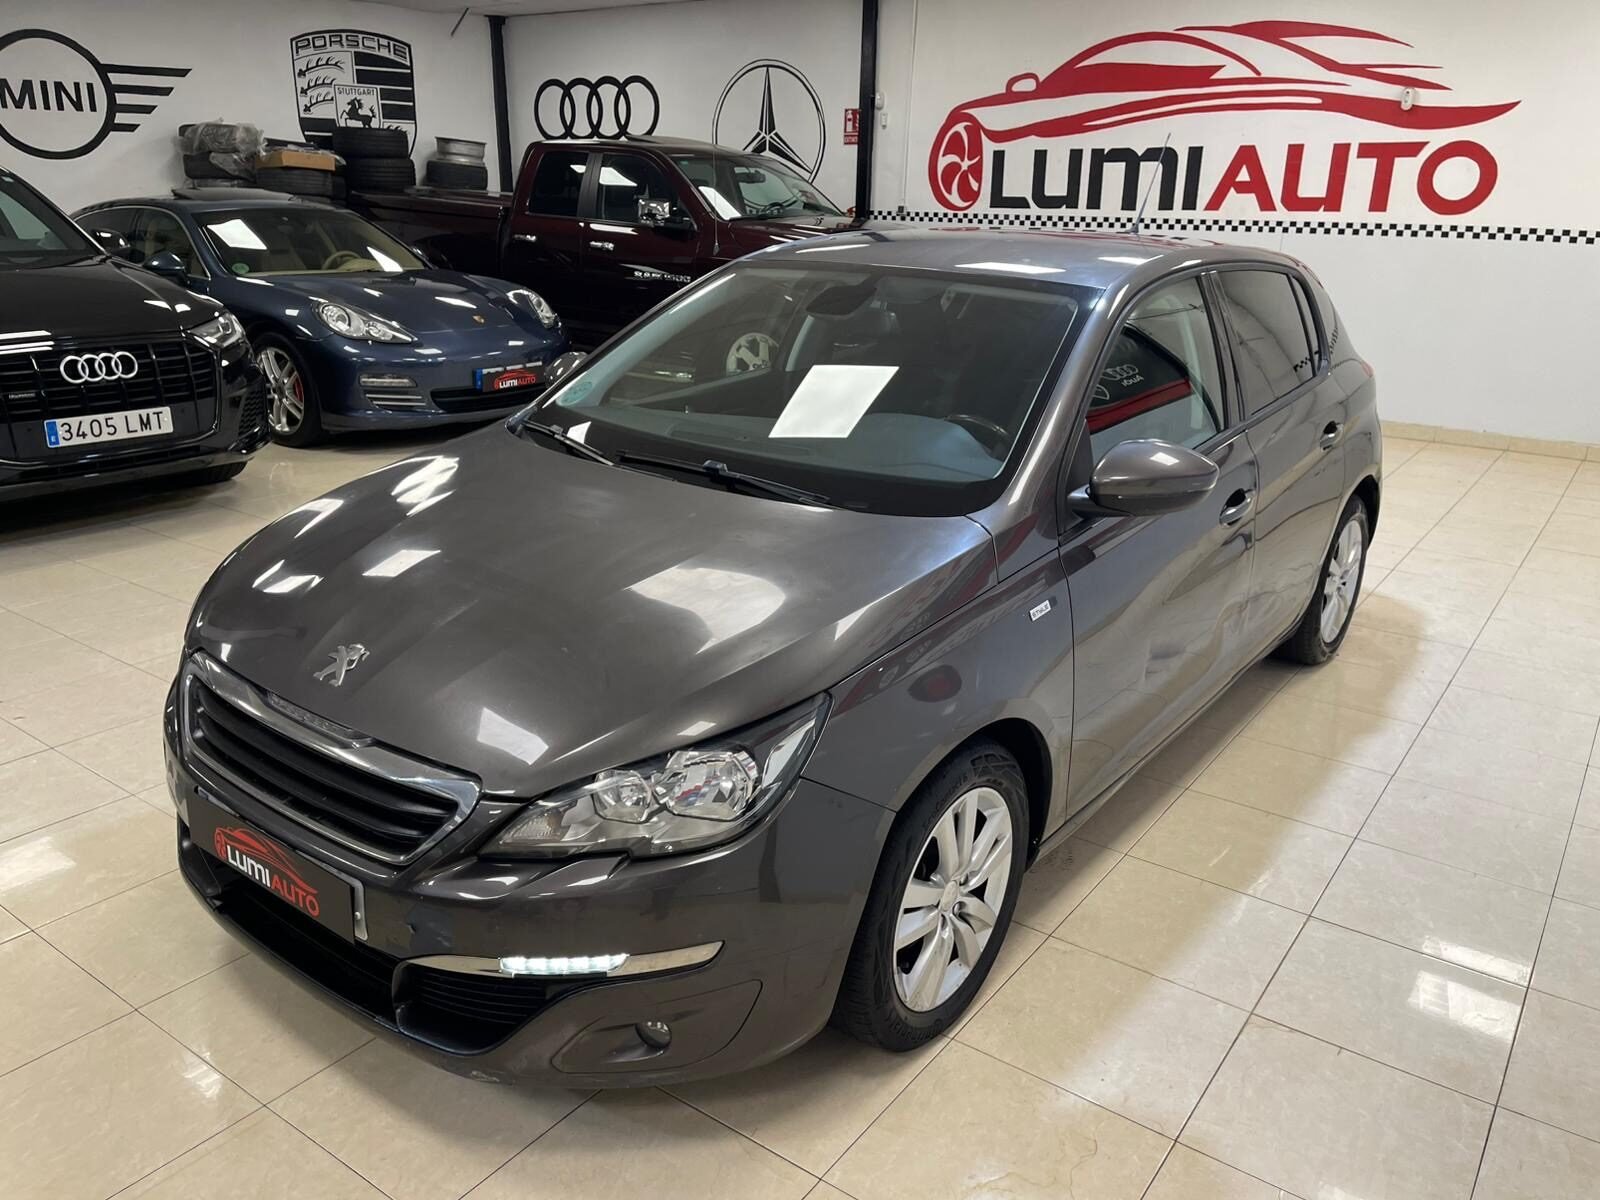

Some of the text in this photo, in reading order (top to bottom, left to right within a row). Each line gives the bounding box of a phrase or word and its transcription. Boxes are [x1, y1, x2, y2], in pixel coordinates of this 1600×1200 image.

[294, 34, 409, 61] PORSCHE
[0, 78, 97, 112] MINI
[337, 87, 375, 96] STUTTGART
[60, 411, 163, 441] 3405 LMT
